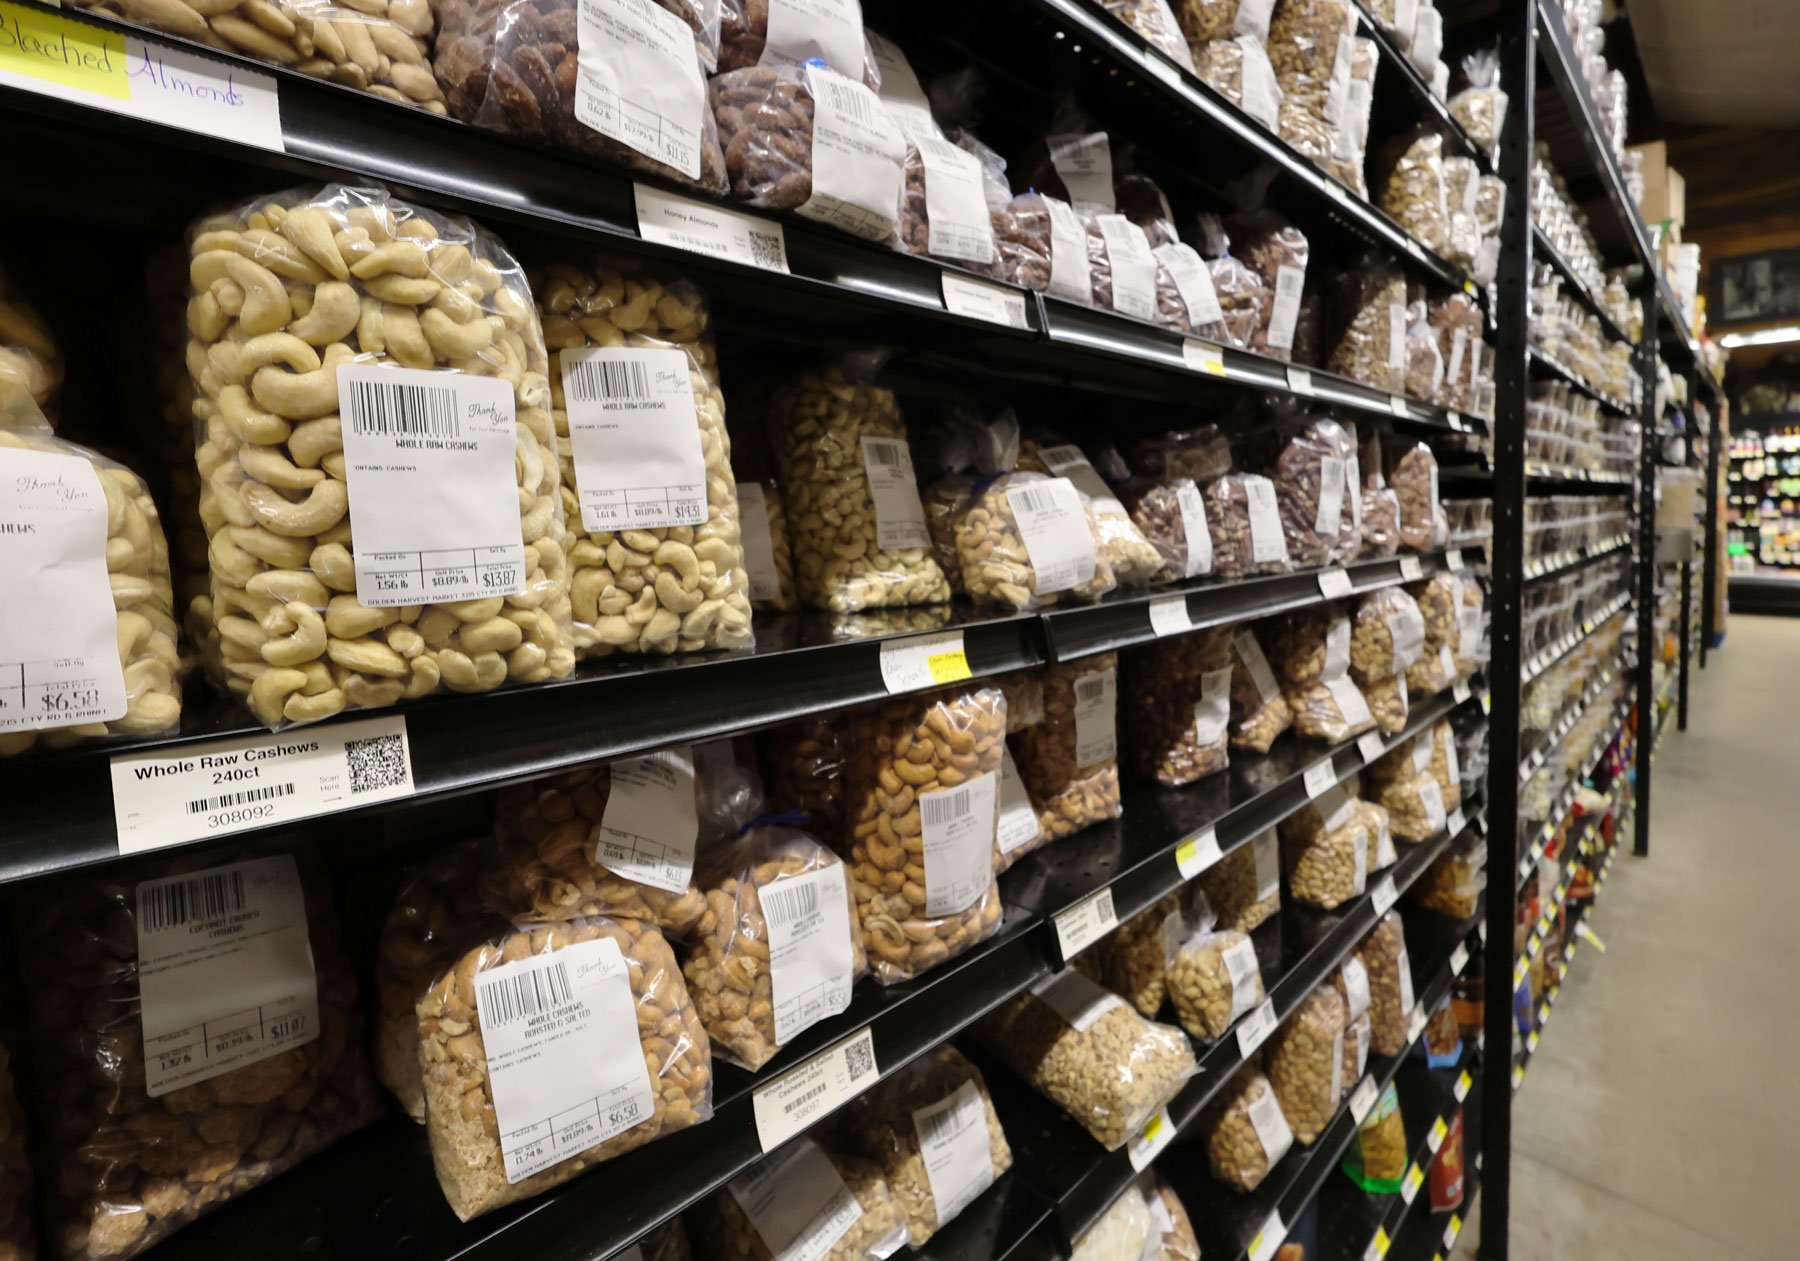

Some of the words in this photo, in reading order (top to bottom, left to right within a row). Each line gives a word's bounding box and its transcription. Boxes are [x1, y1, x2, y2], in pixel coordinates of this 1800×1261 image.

[125, 47, 244, 108] Almonds
[664, 208, 687, 222] Honey
[688, 215, 719, 230] Almonds
[656, 370, 676, 384] Thank
[468, 402, 496, 418] Thank
[602, 402, 622, 411] WHOLE
[639, 402, 666, 410] CASHEWS
[490, 412, 509, 426] You
[396, 439, 424, 450] WHOLE
[426, 440, 444, 450] RAW
[446, 441, 478, 450] CASHEWS
[16, 475, 64, 492] Thank
[674, 504, 700, 518] $14.31
[378, 580, 398, 590] 1.56
[400, 580, 408, 590] lb
[483, 570, 516, 588] $13.87
[42, 690, 98, 712] $6.58
[134, 760, 195, 781] Whole
[200, 754, 239, 770] Raw
[244, 740, 320, 762] Cashews
[212, 766, 260, 786] 240ct
[318, 774, 340, 784] Scan
[320, 783, 340, 792] Here
[208, 804, 276, 829] 308092
[528, 1012, 550, 1027] WHOLE
[552, 1001, 584, 1018] CASHEWS
[524, 1022, 556, 1040] ROASTED
[564, 1008, 590, 1024] SALTED
[763, 1084, 782, 1098] Whole
[784, 1067, 809, 1086] Roasted
[778, 1080, 806, 1099] Cashews
[608, 1102, 640, 1128] $6.58
[515, 1150, 536, 1165] 0.74
